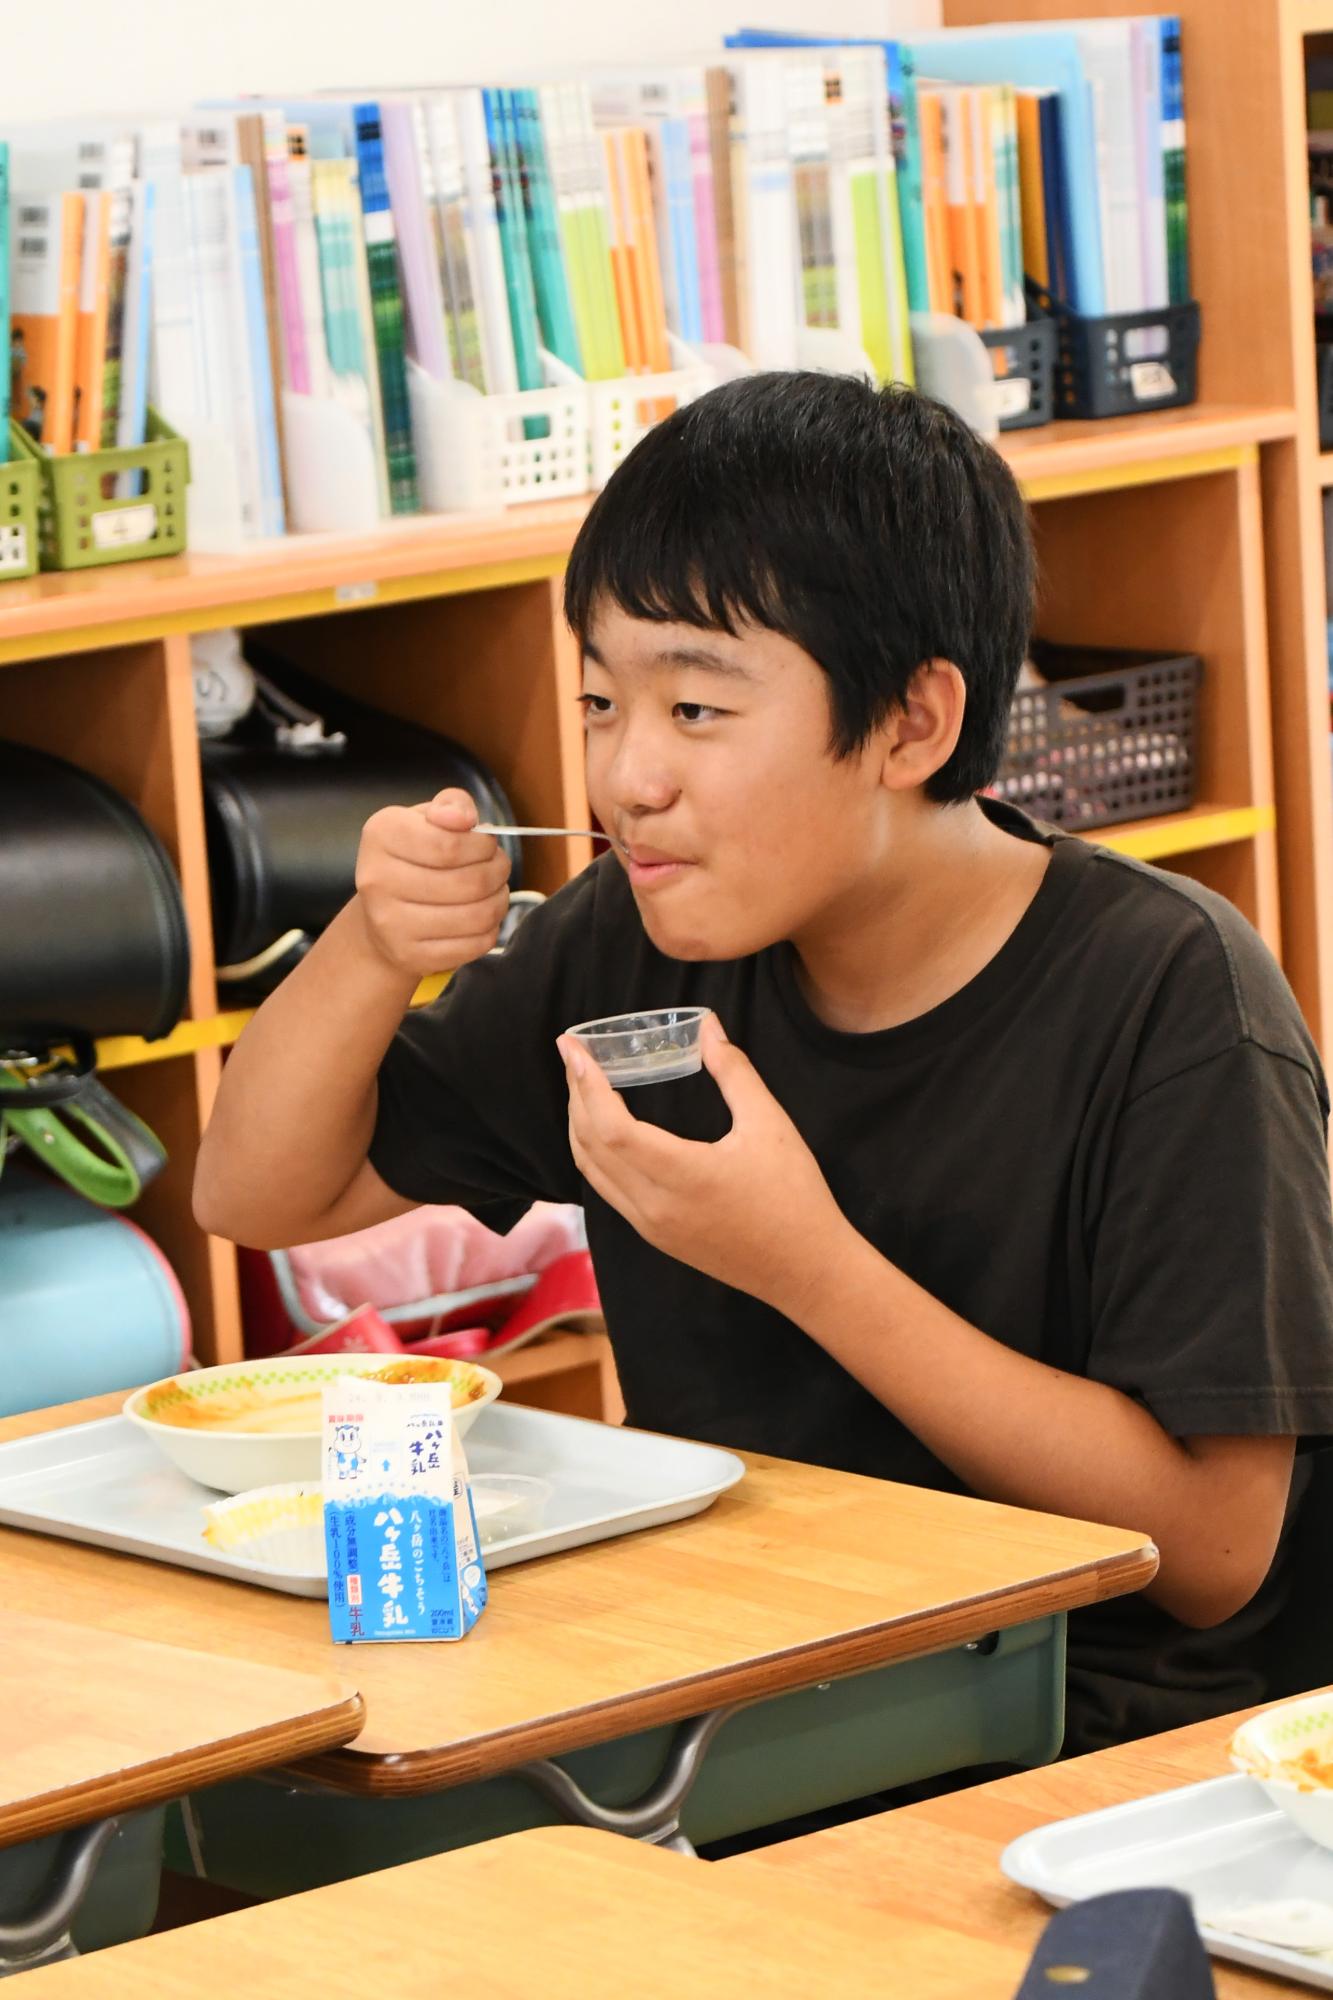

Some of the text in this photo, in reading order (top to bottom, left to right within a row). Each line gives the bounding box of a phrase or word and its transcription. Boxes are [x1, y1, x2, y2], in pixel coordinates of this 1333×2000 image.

[409, 1441, 426, 1475] 牛乳
[425, 1430, 442, 1469] 八ヶ岳
[373, 1507, 409, 1628] 八ヶ岳牛乳
[349, 1607, 365, 1637] 牛乳
